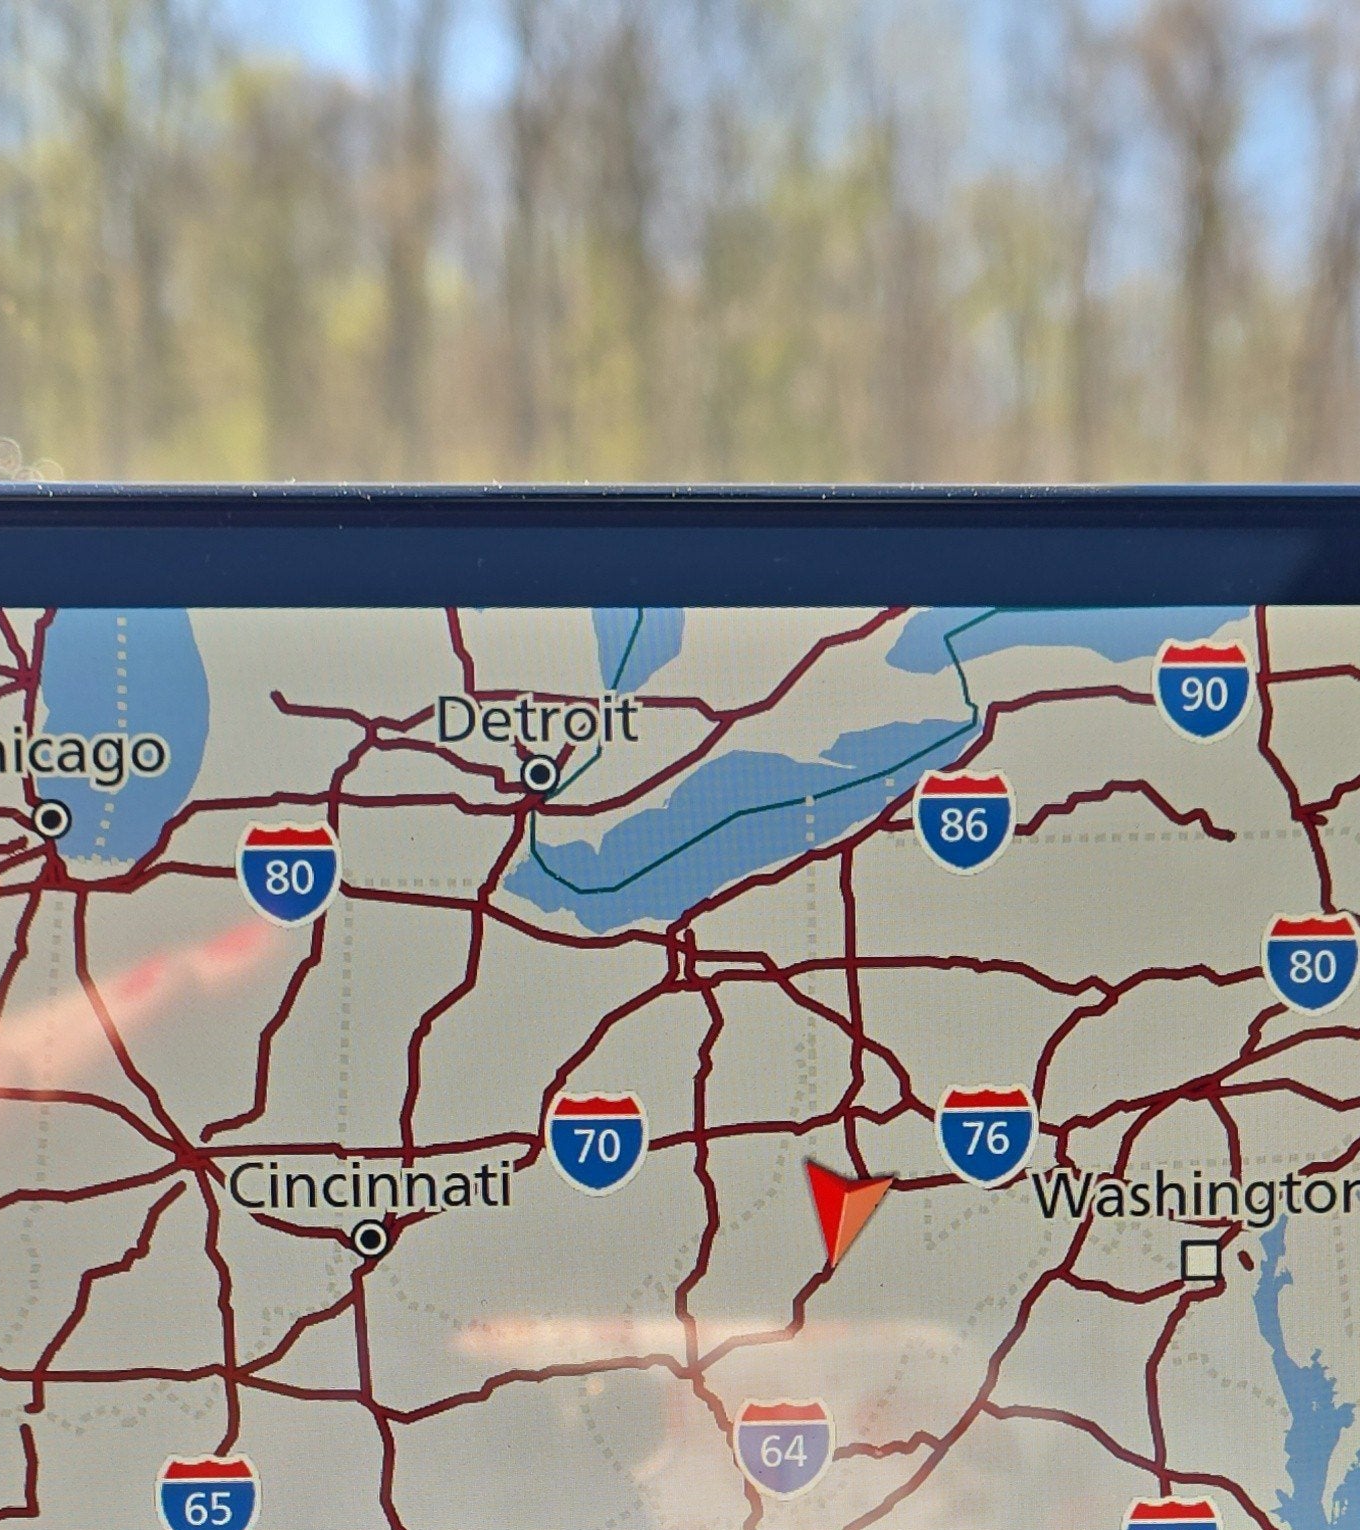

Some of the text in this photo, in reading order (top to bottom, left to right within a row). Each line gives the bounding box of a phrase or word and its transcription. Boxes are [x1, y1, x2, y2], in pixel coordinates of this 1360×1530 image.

[1182, 676, 1228, 711] 90
[439, 694, 639, 742] Detroit
[942, 807, 988, 843] 86
[266, 861, 314, 897] 80
[1290, 949, 1337, 985] 80
[574, 1128, 620, 1164] 70
[962, 1122, 1010, 1158] 76
[230, 1163, 512, 1210] Cincinnati
[761, 1434, 807, 1467] 64
[184, 1492, 232, 1527] 65
